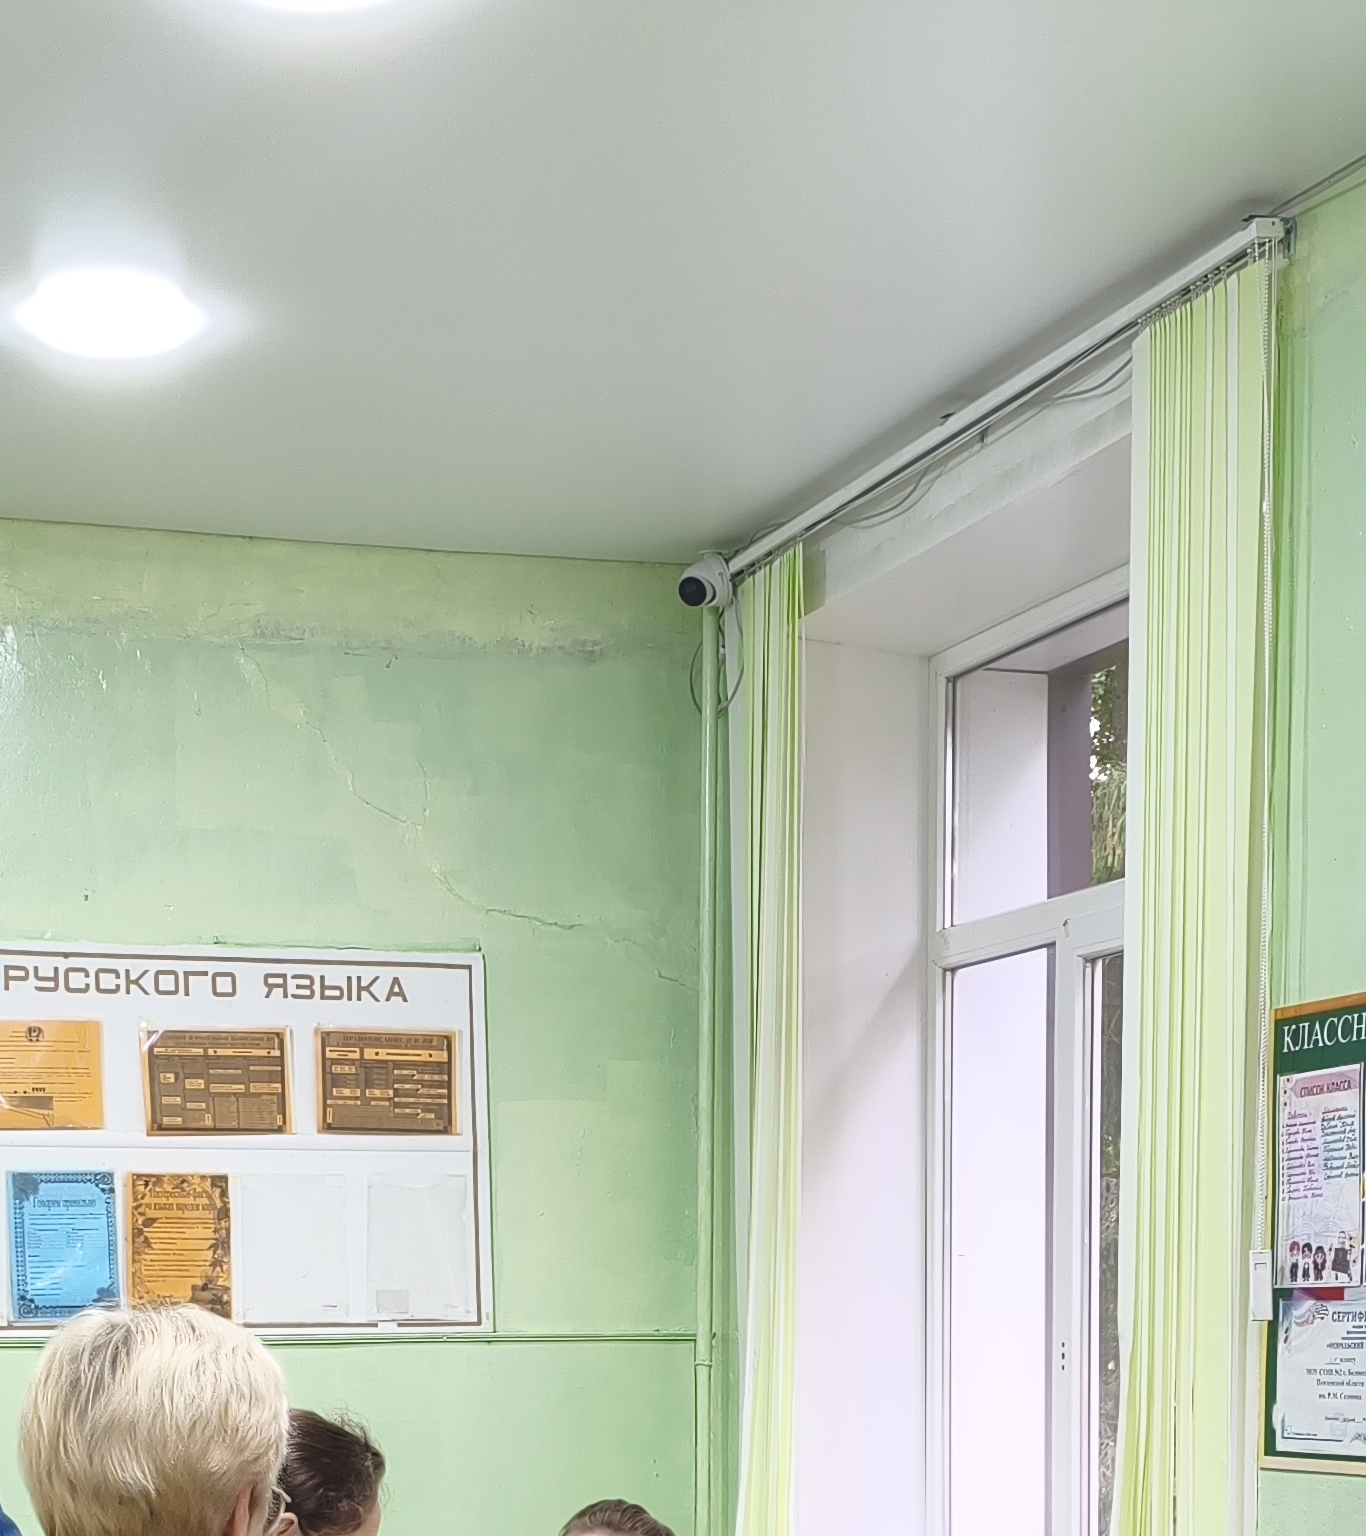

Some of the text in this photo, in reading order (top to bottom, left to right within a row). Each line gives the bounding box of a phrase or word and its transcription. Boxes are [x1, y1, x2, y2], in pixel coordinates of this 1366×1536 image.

[3, 964, 238, 1000] РУССКОГО
[262, 970, 410, 1004] ЯЗЫКА
[1299, 1079, 1352, 1098] СПИСОК КЛАССА
